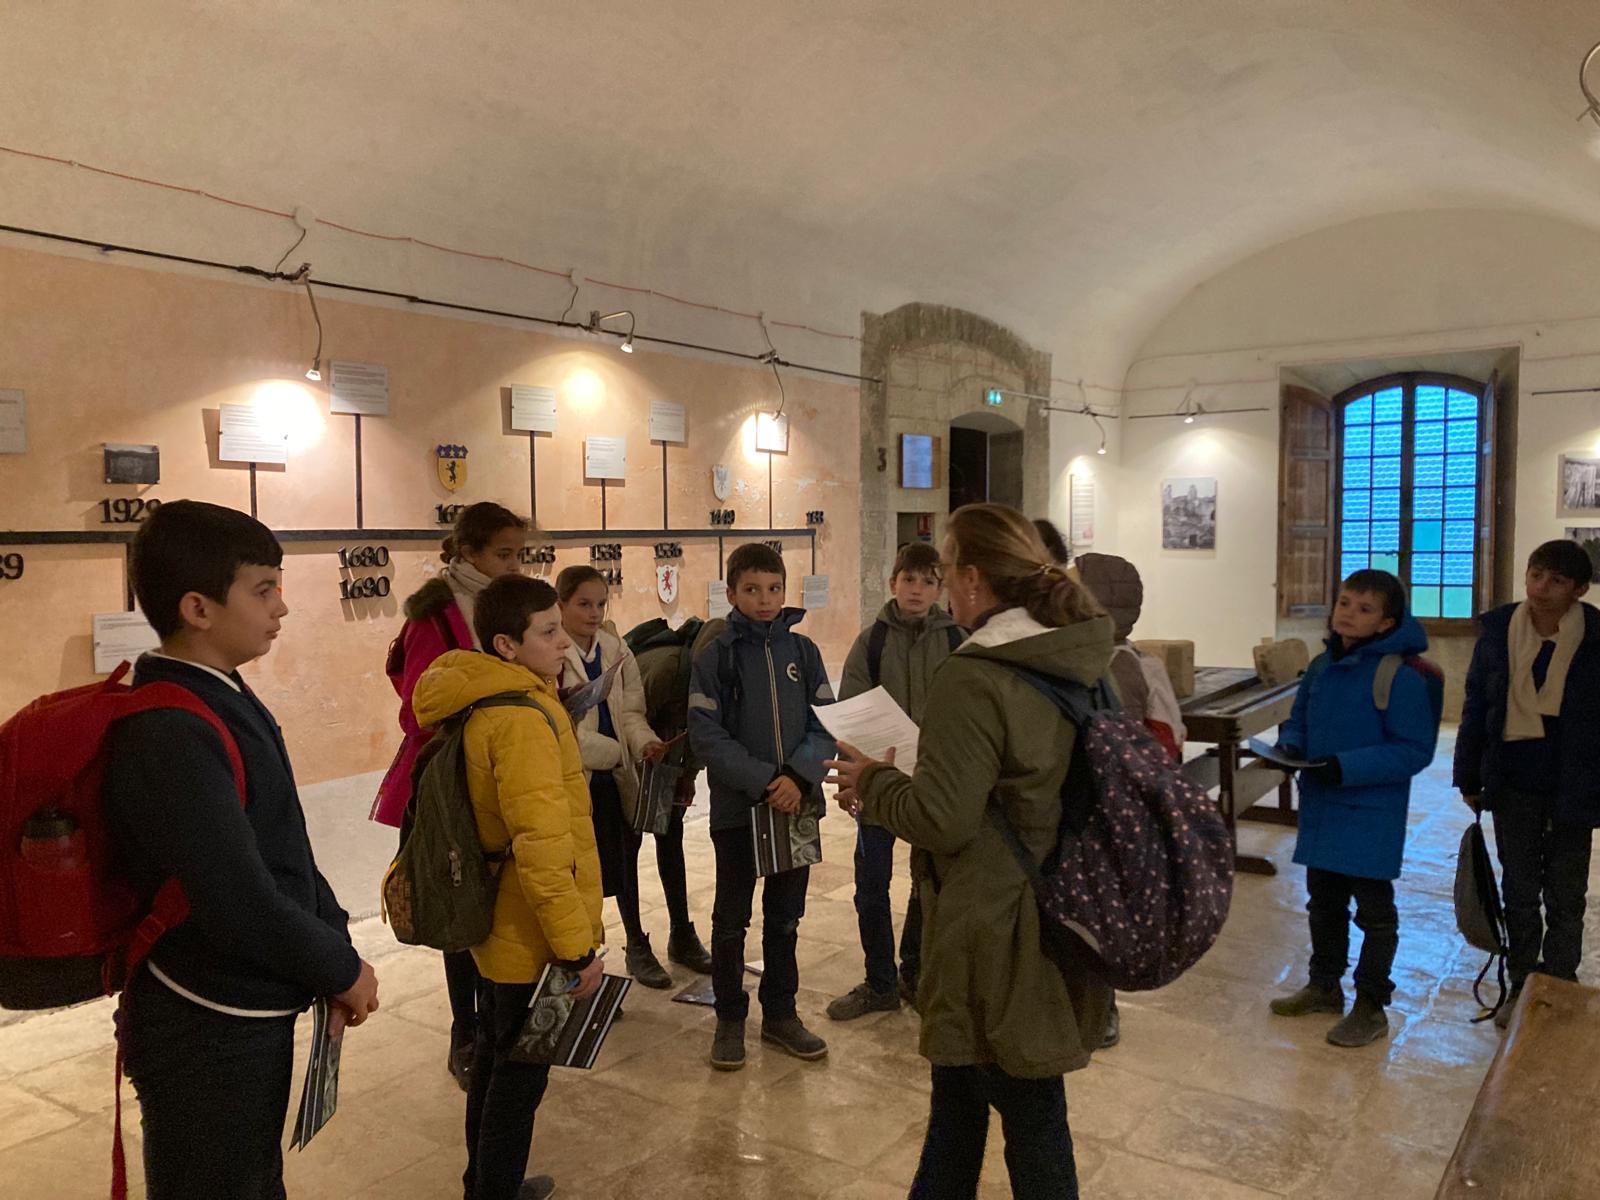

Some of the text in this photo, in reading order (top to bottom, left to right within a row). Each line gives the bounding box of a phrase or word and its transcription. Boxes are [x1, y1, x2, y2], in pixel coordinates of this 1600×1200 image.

[0, 552, 25, 580] 9
[337, 545, 390, 569] 1680
[338, 575, 392, 600] 1690
